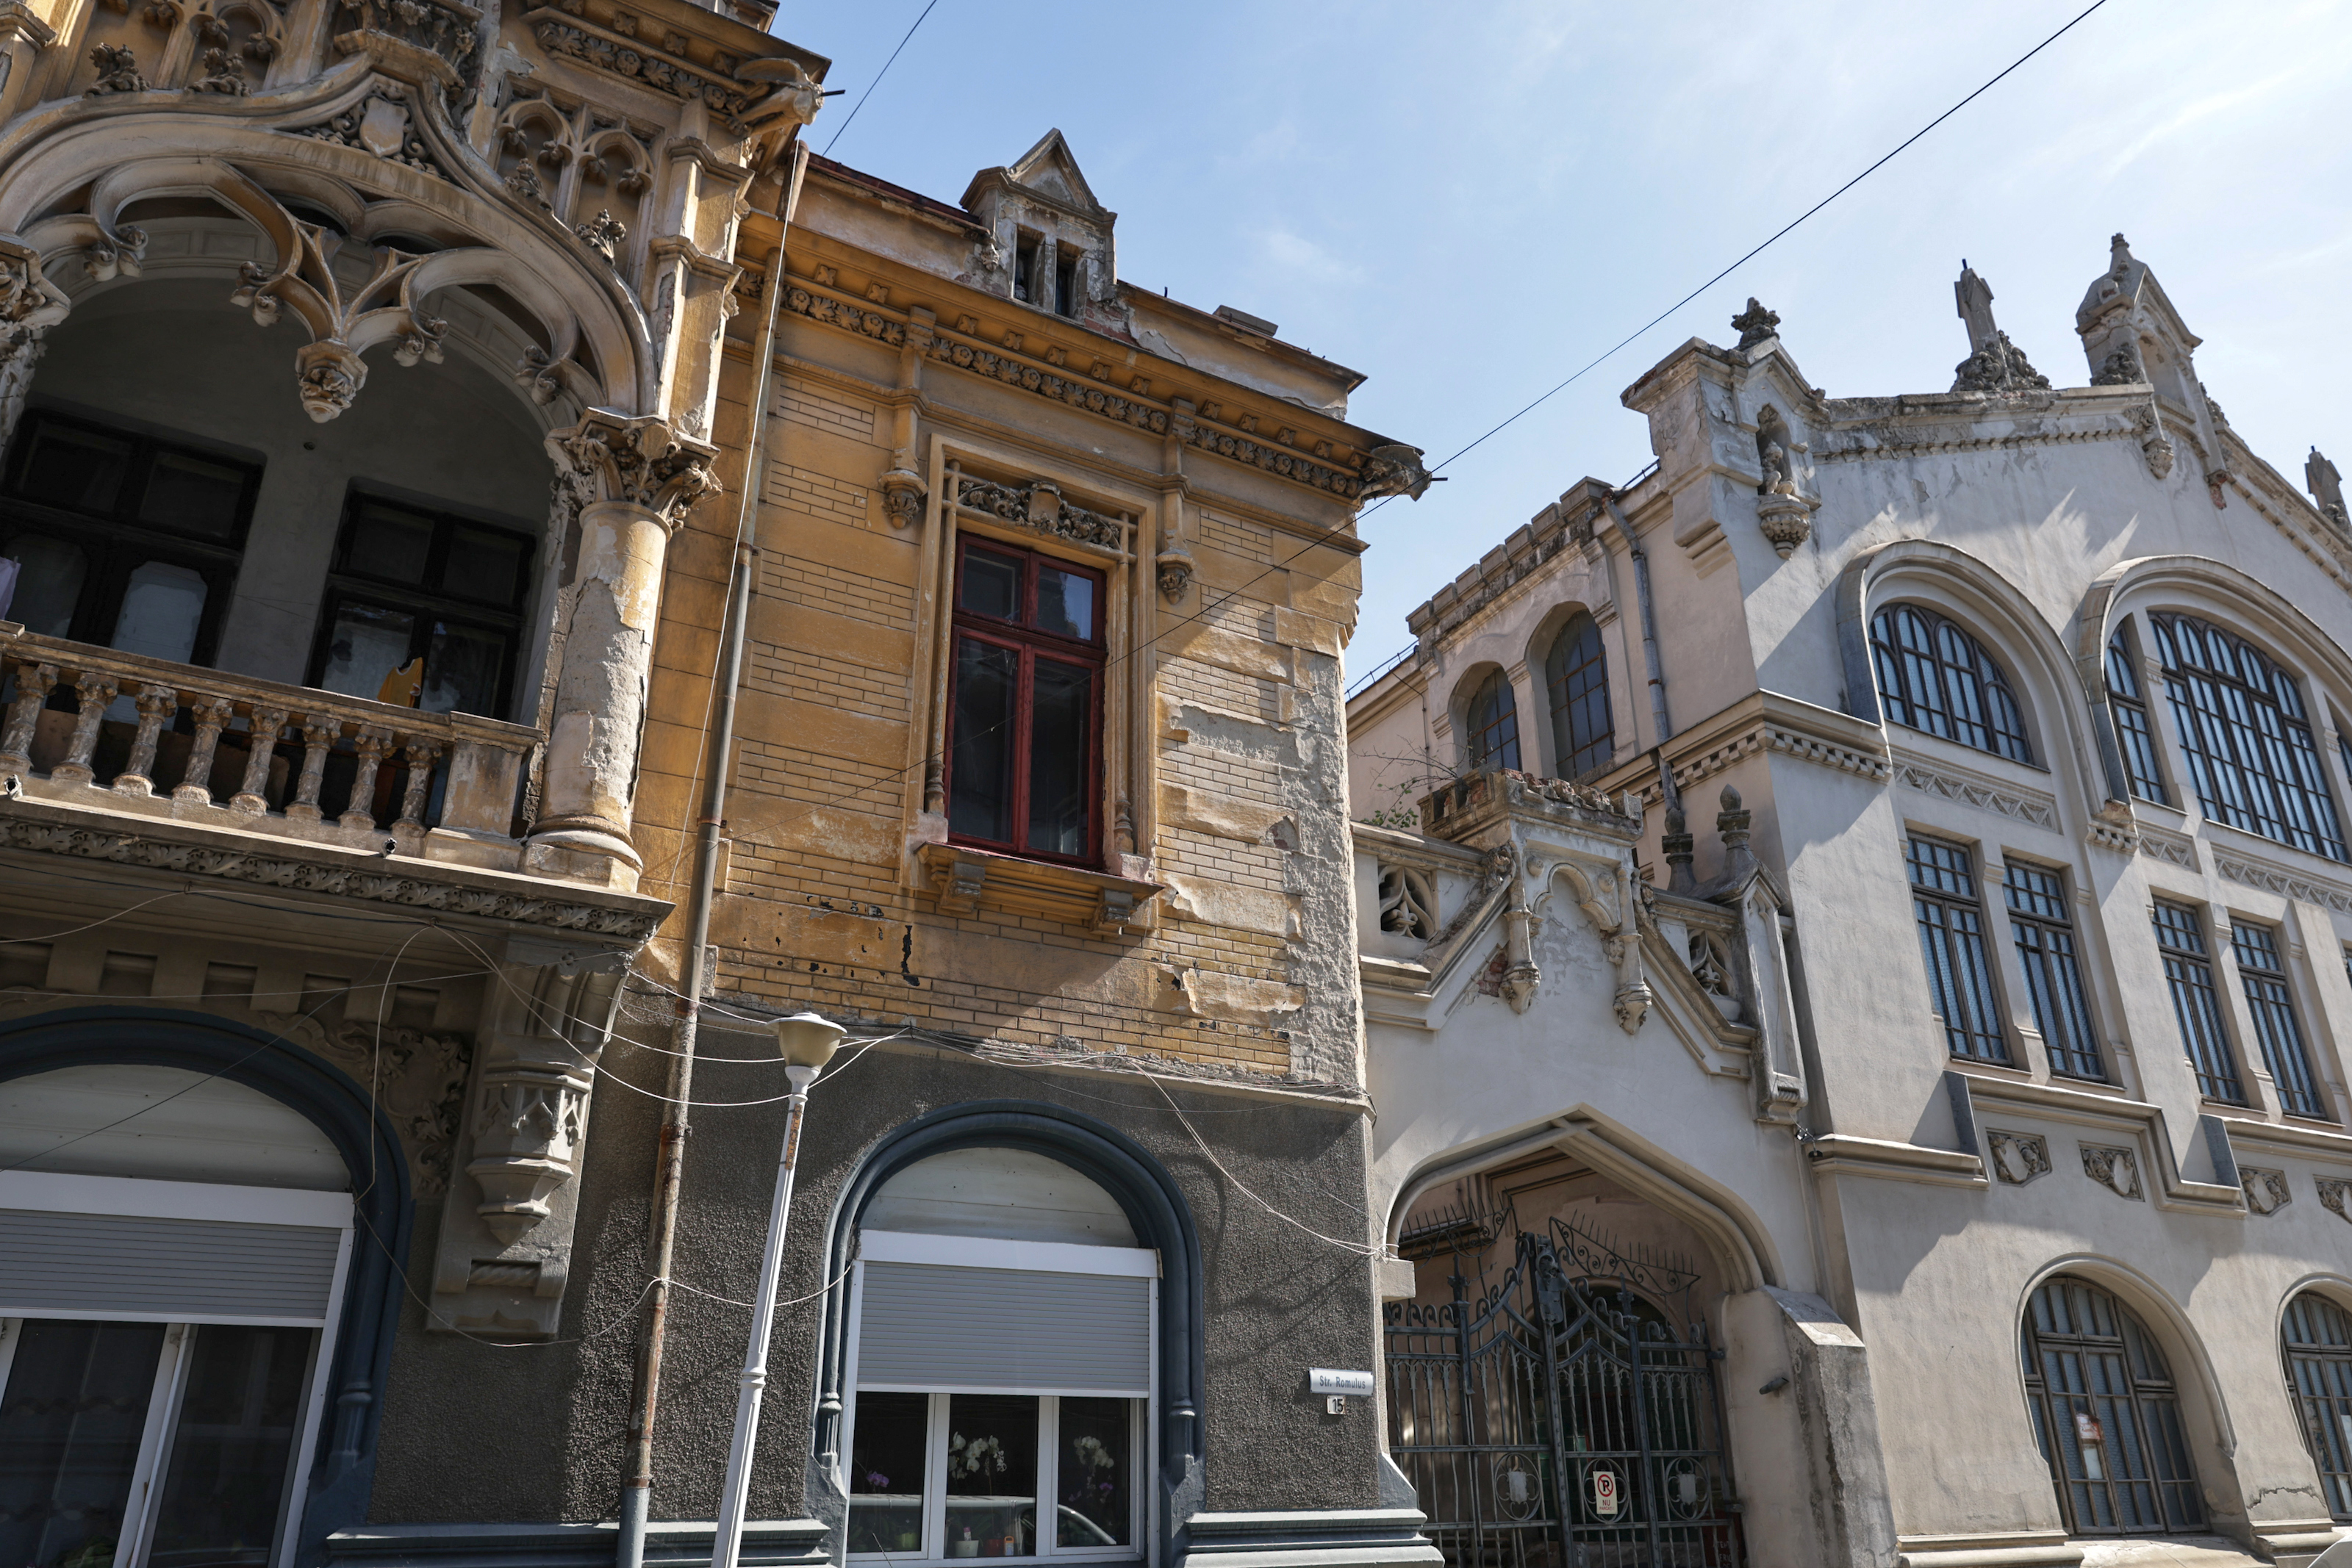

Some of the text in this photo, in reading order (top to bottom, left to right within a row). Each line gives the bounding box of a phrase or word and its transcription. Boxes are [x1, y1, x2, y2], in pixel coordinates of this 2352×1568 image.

[1319, 1375, 1366, 1389] Str. Romulus
[1332, 1398, 1344, 1412] 15
